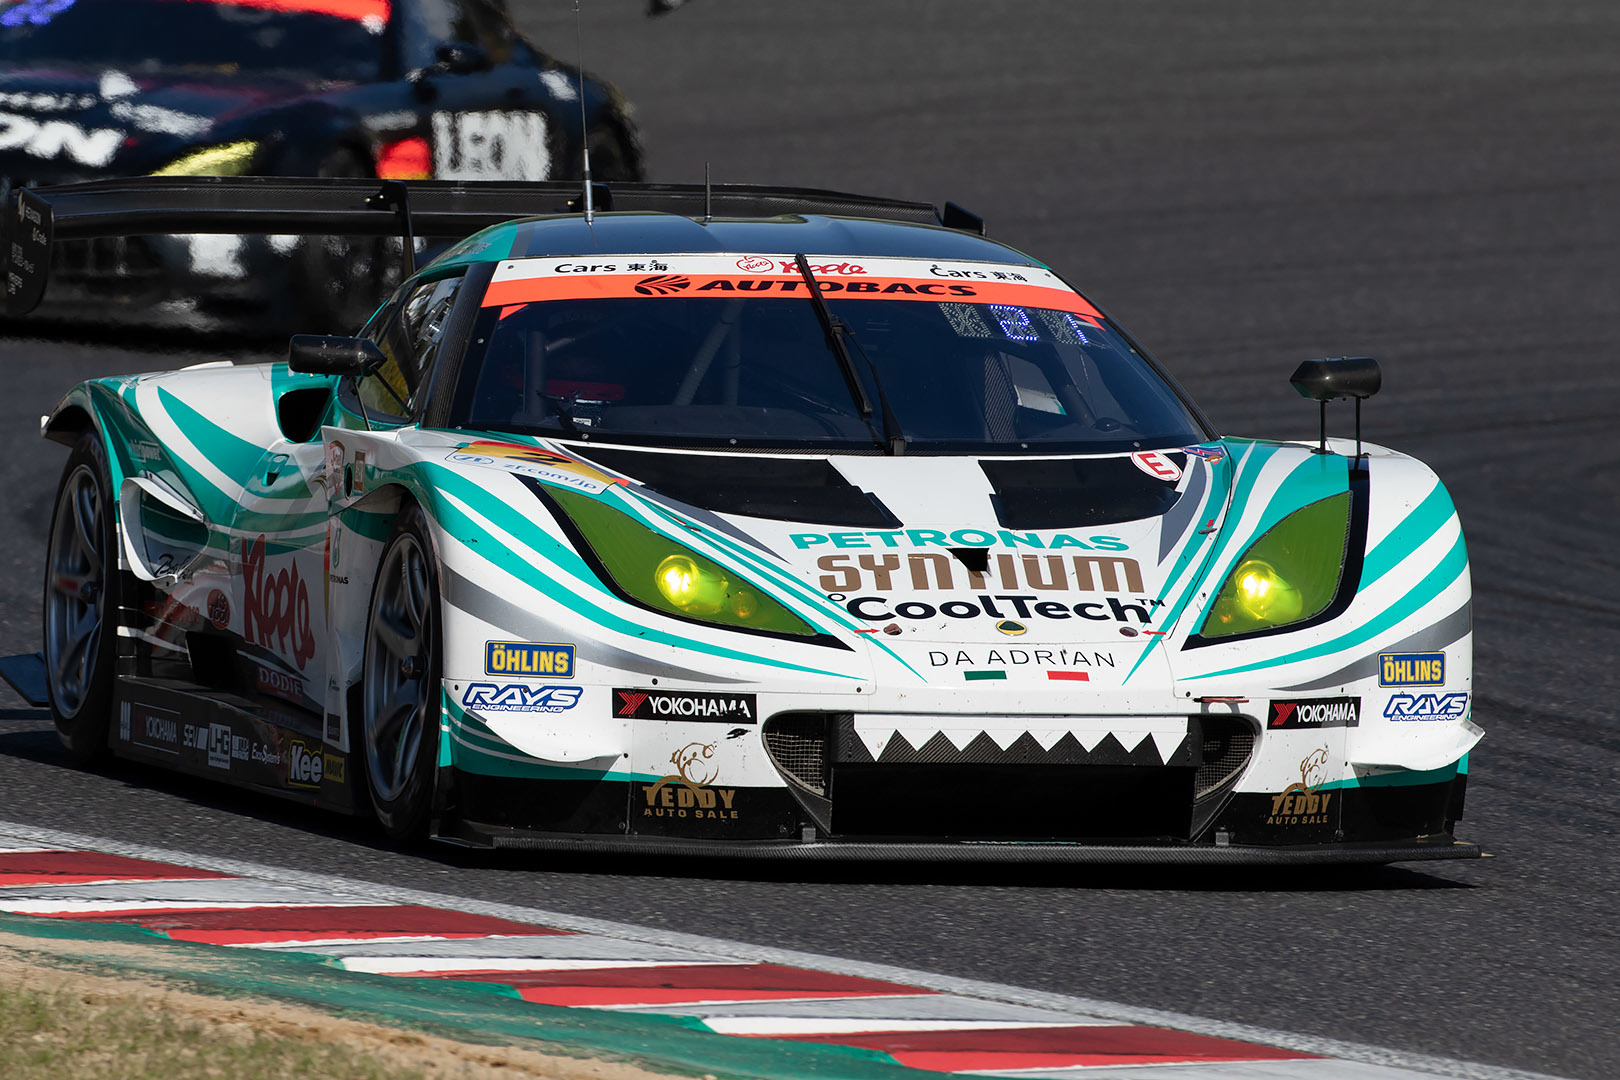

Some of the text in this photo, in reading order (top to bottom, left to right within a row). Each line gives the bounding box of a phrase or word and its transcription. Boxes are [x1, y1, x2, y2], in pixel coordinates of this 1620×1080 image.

[555, 262, 668, 274] Cars 東海
[929, 264, 1028, 283] Cars 東海
[696, 279, 978, 297] AUTOBACS
[1137, 453, 1175, 476] E
[503, 464, 598, 490] zf.com/jp
[788, 529, 1130, 552] PETRONAS
[491, 644, 570, 674] ÖHLINS
[929, 649, 1115, 667] DA ADRIAN
[1383, 656, 1442, 684] ÖHLINS
[465, 686, 583, 706] RAYS
[1387, 694, 1467, 714] RAYS
[471, 703, 565, 713] ENGINEERING
[648, 696, 752, 719] YOKOHAMA
[1295, 702, 1357, 724] YOKOHAMA
[1391, 713, 1459, 721] ENGINEERING
[643, 785, 736, 809] TEDDY
[1271, 792, 1331, 815] TEDDY
[643, 807, 739, 819] AUTO SALE
[1267, 815, 1329, 825] AUTO SALE
